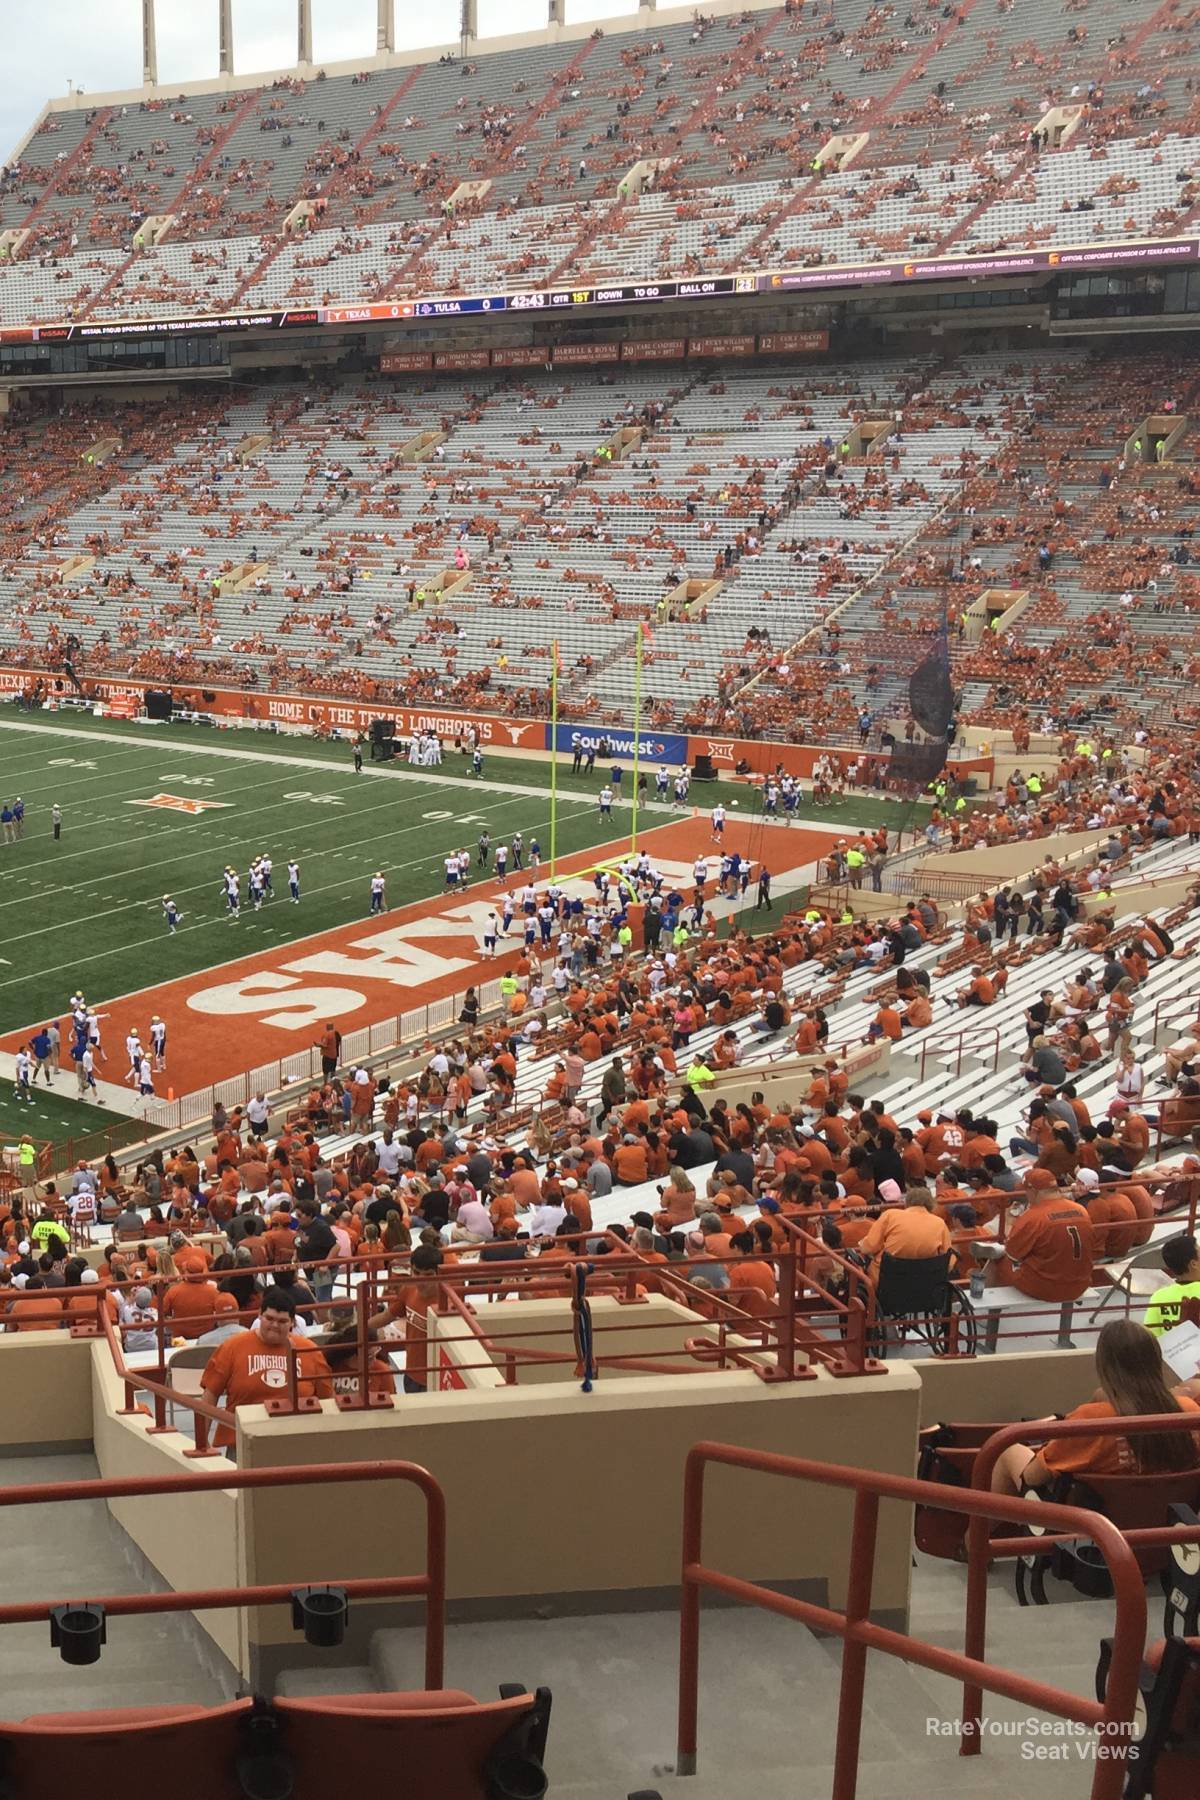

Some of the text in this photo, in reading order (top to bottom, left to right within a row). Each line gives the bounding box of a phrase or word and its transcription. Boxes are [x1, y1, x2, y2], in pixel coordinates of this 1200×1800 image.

[597, 287, 659, 300] DOWN TO GO
[680, 283, 715, 294] BALL ON
[511, 294, 544, 307] 42:43
[553, 292, 589, 304] QTR 1ST
[434, 299, 491, 313] TULSA 0
[345, 307, 399, 319] TEXAS 0
[689, 342, 701, 352] 34
[762, 338, 772, 348] 12
[623, 346, 634, 355] 20
[269, 701, 303, 719] HOME
[328, 707, 355, 725] THE
[942, 1129, 964, 1147] 42
[78, 1196, 93, 1209] 28
[1066, 1225, 1082, 1260] 1
[247, 1354, 303, 1377] LONGHOS
